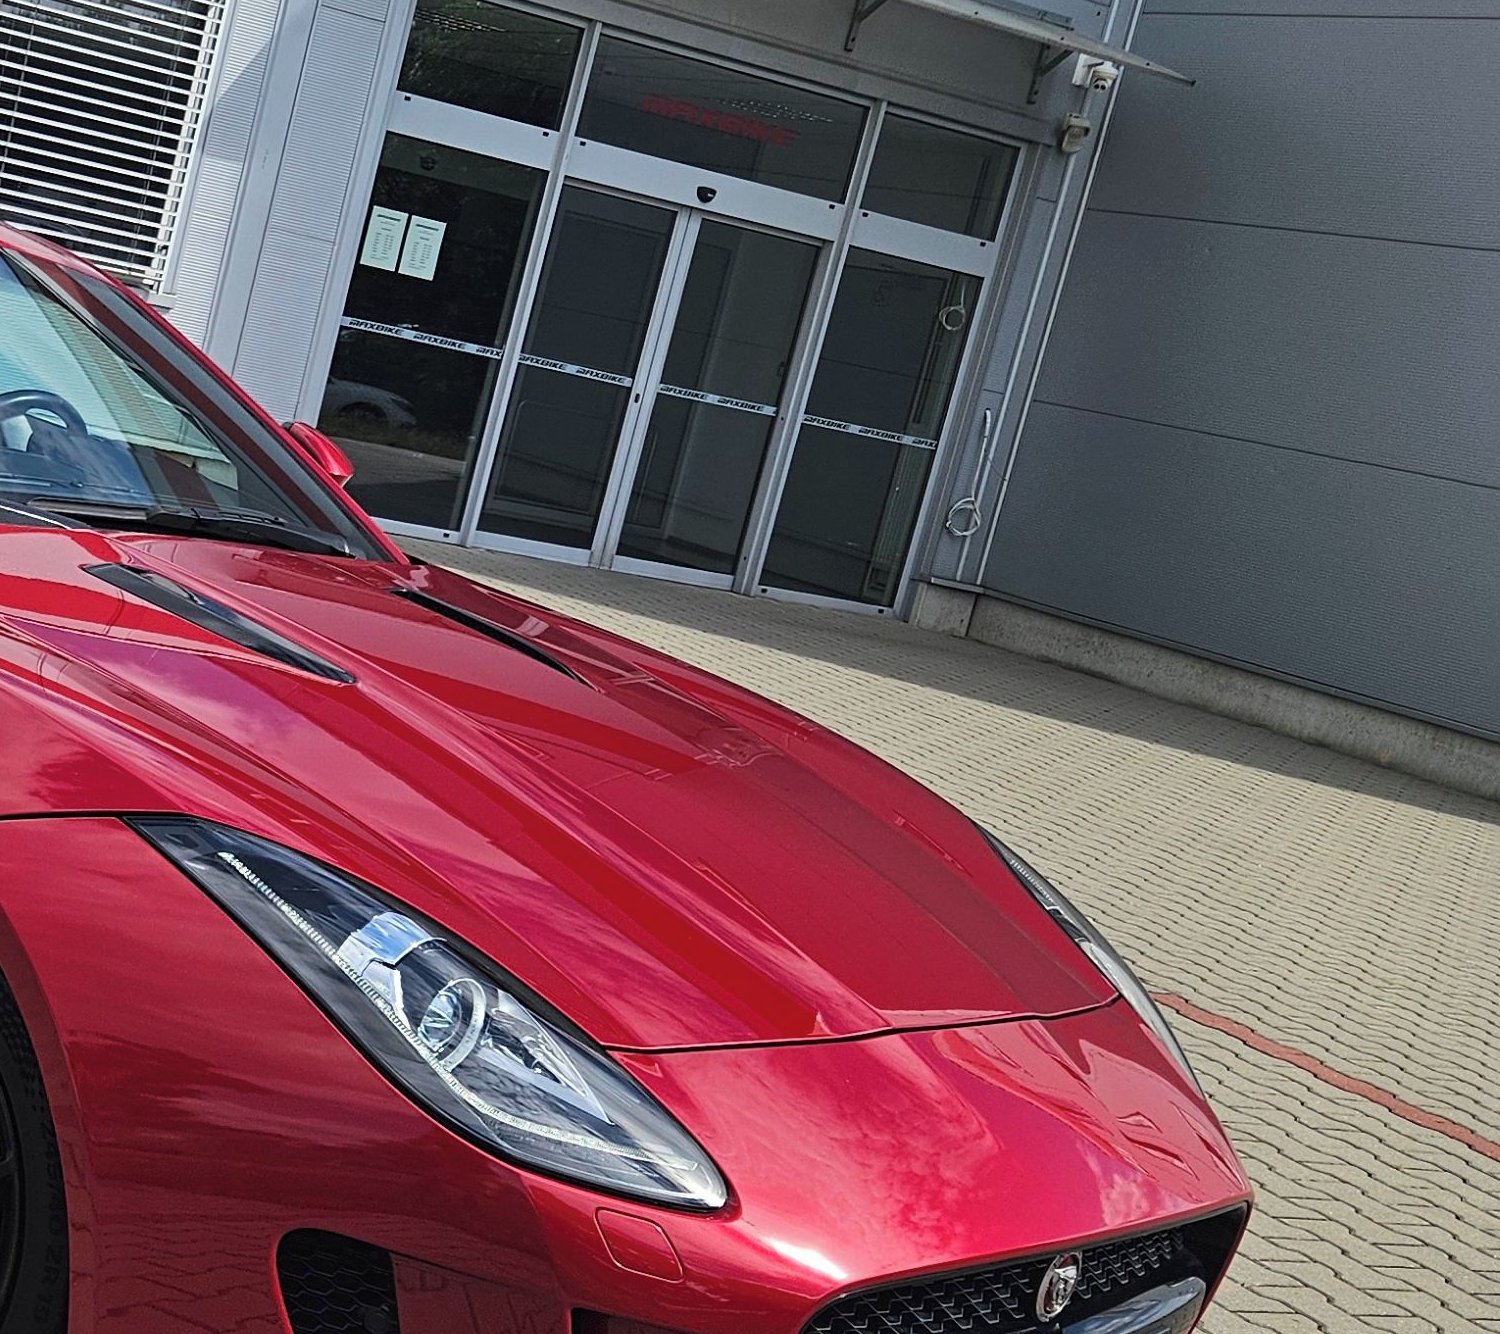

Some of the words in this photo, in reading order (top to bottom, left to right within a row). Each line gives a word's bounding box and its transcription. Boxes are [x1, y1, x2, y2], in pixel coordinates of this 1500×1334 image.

[349, 319, 403, 336] MAXBIKE
[413, 333, 467, 350] MAXBIKE
[576, 367, 626, 384] MAXBIKE
[660, 385, 708, 400] MAXBIKE
[717, 398, 764, 412] MAXBIKE
[804, 415, 850, 430] MAXBIKE
[858, 427, 903, 442] MAXBIKE
